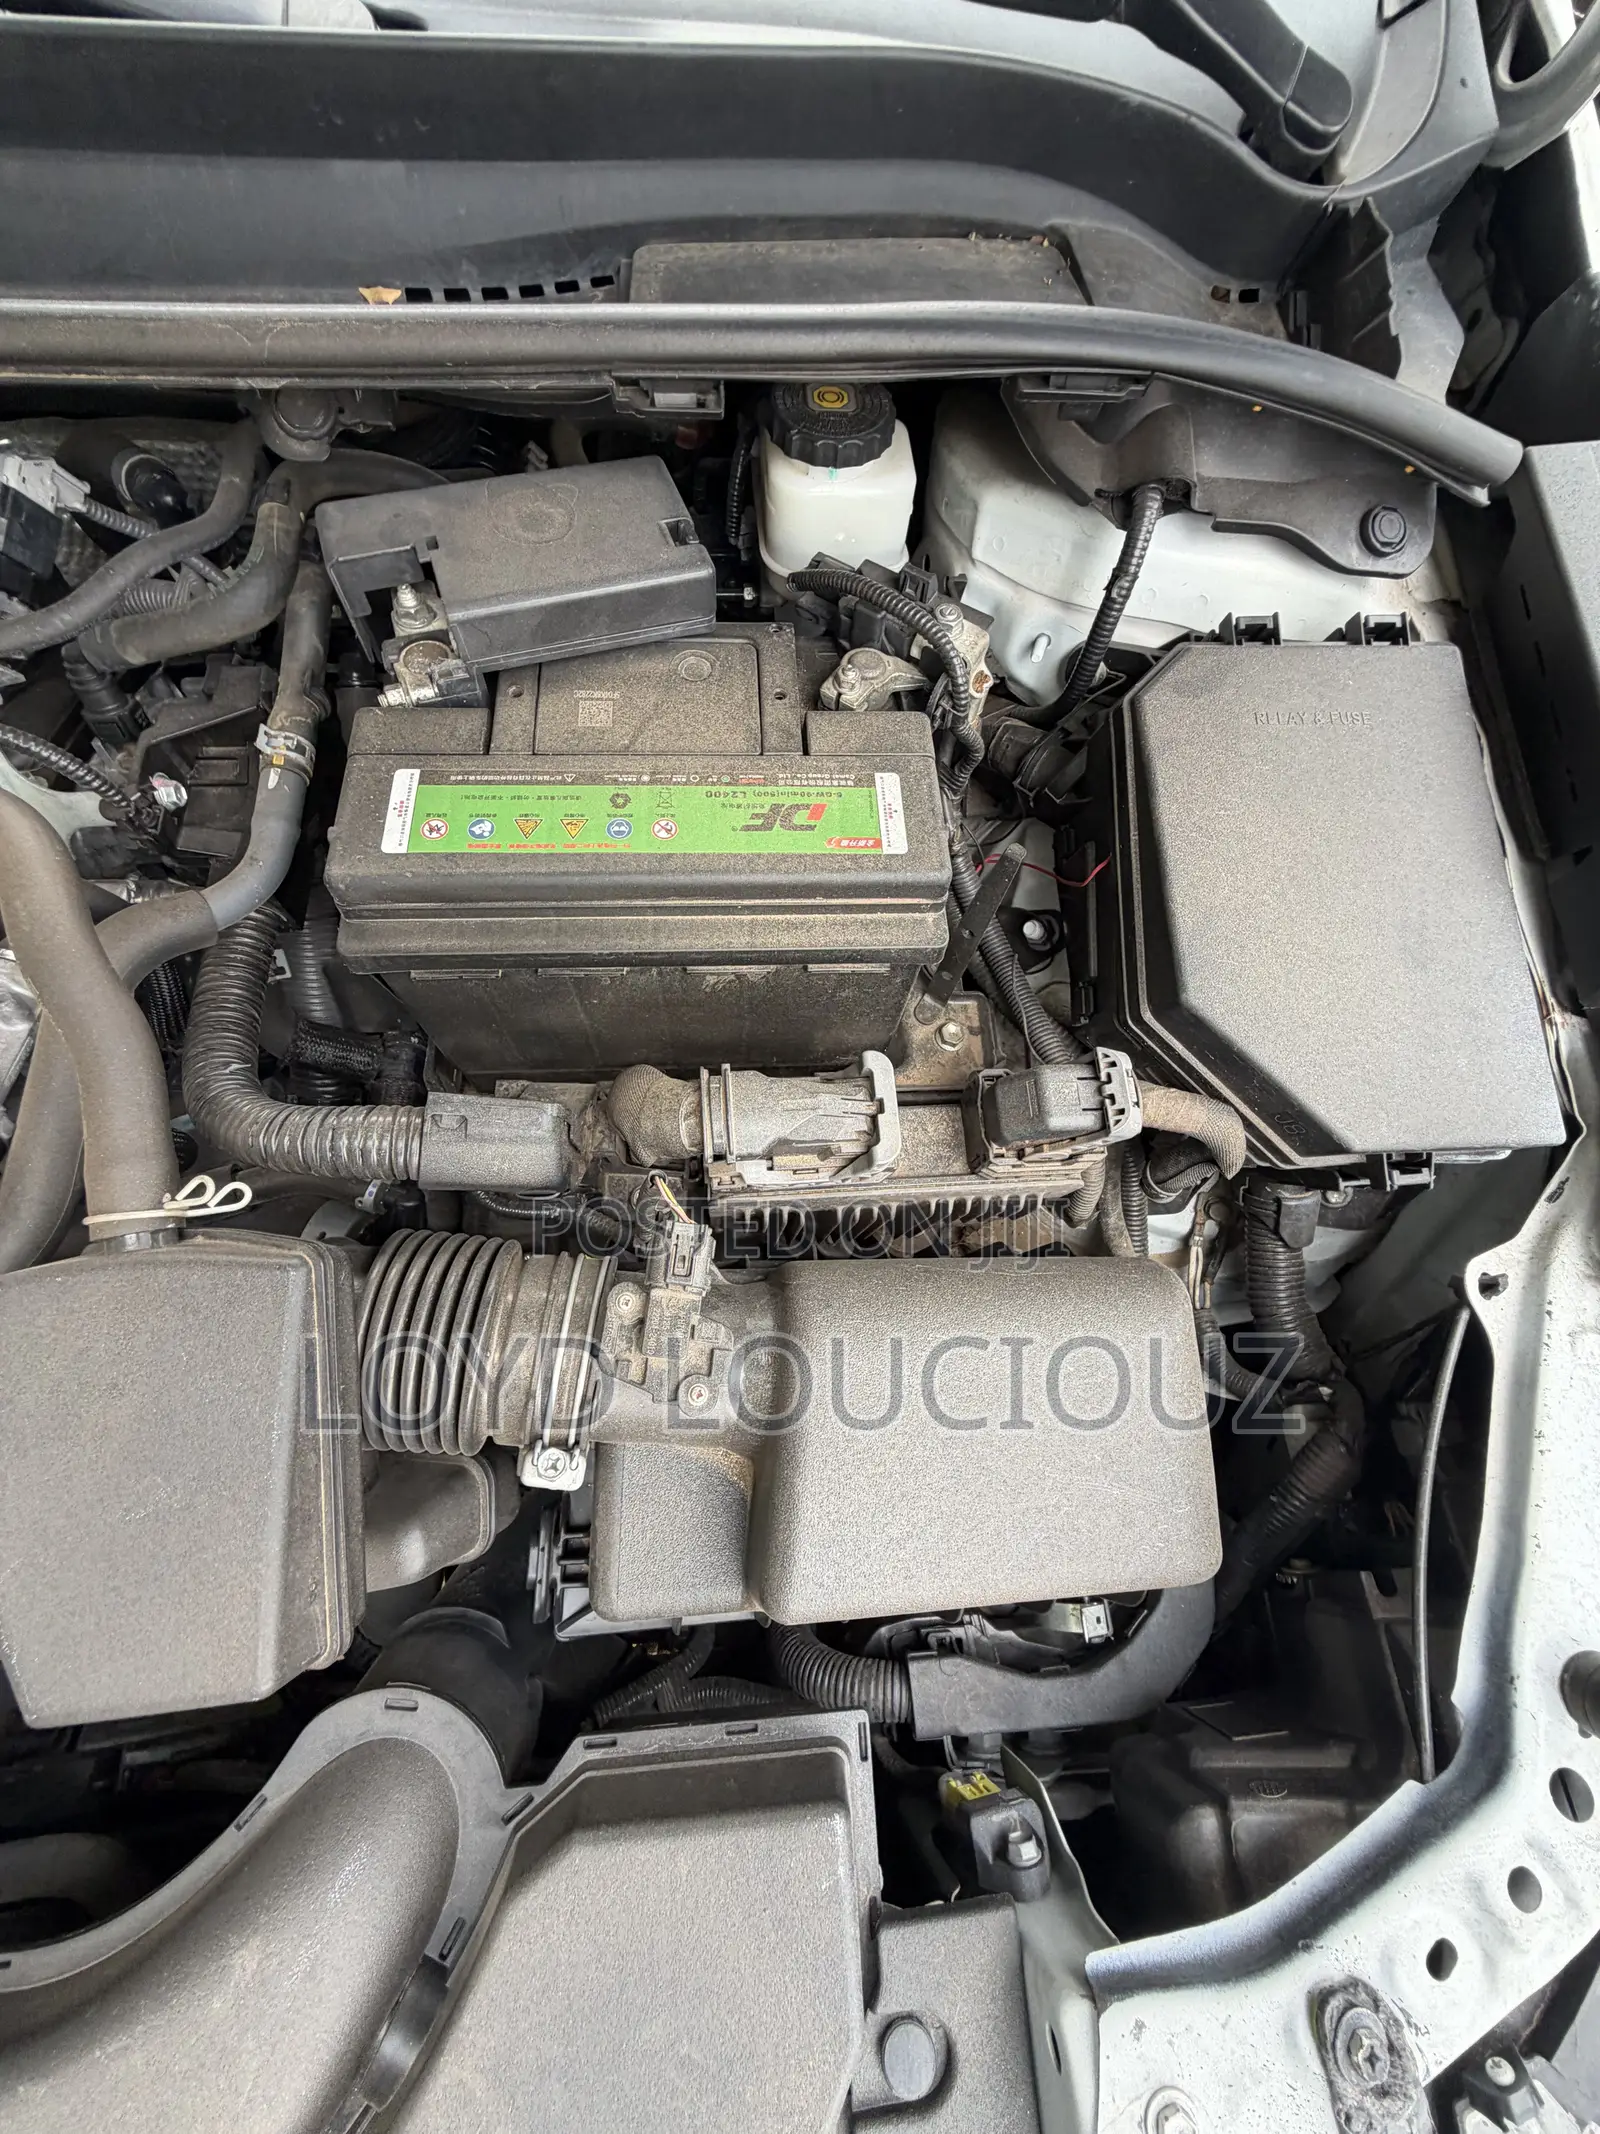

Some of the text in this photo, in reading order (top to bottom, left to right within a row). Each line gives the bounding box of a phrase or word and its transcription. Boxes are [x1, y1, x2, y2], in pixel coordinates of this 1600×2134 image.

[1253, 711, 1371, 726] RELAY & FUSE
[705, 790, 747, 799] L2400
